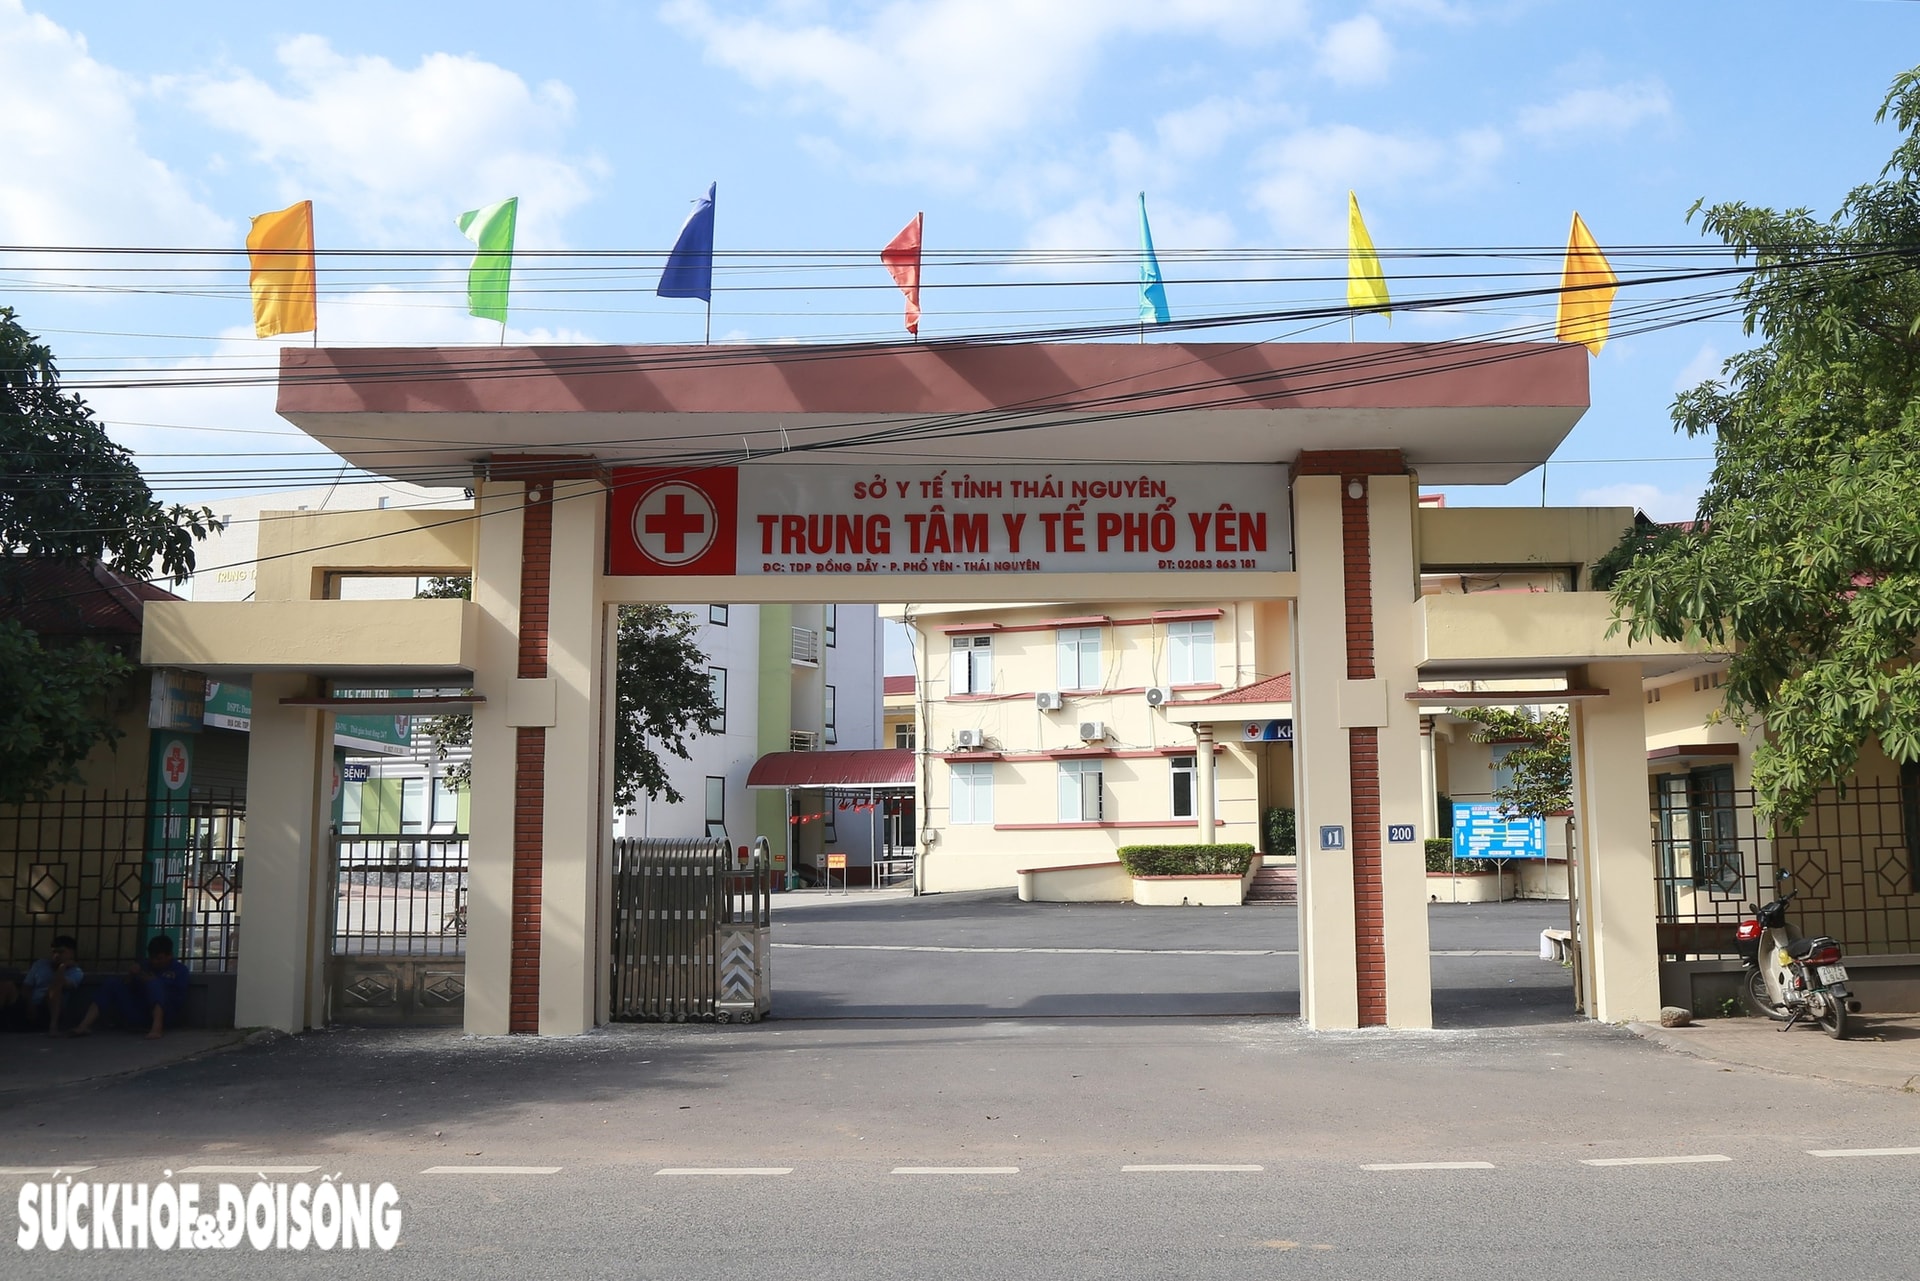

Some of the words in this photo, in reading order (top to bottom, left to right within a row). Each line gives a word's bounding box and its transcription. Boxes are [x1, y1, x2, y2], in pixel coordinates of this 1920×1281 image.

[854, 474, 888, 500] SỞ
[896, 480, 911, 499] Y
[920, 469, 947, 499] TẾ
[951, 474, 1002, 499] TỈNH
[1010, 474, 1064, 498] THÁI
[1072, 475, 1166, 498] NGUYÊN
[756, 513, 891, 555] TRUNG
[904, 504, 989, 554] TÂM
[1002, 513, 1027, 553] Y
[1039, 499, 1088, 553] TẾ
[1097, 496, 1177, 553] PHỔ
[1188, 503, 1267, 552] YÊN
[762, 561, 785, 573] ĐC:
[790, 562, 812, 572] TDP
[816, 558, 852, 573] ĐỒNG
[890, 561, 901, 573] P.
[903, 557, 928, 572] PHỔ
[932, 558, 953, 572] YÊN
[963, 558, 990, 572] THÁI
[994, 558, 1040, 571] NGUYÊN
[1158, 559, 1175, 570] ĐT:
[1216, 559, 1237, 569] 863
[1240, 559, 1256, 569] 181
[344, 765, 366, 780] BỆNH
[1391, 827, 1412, 841] 200
